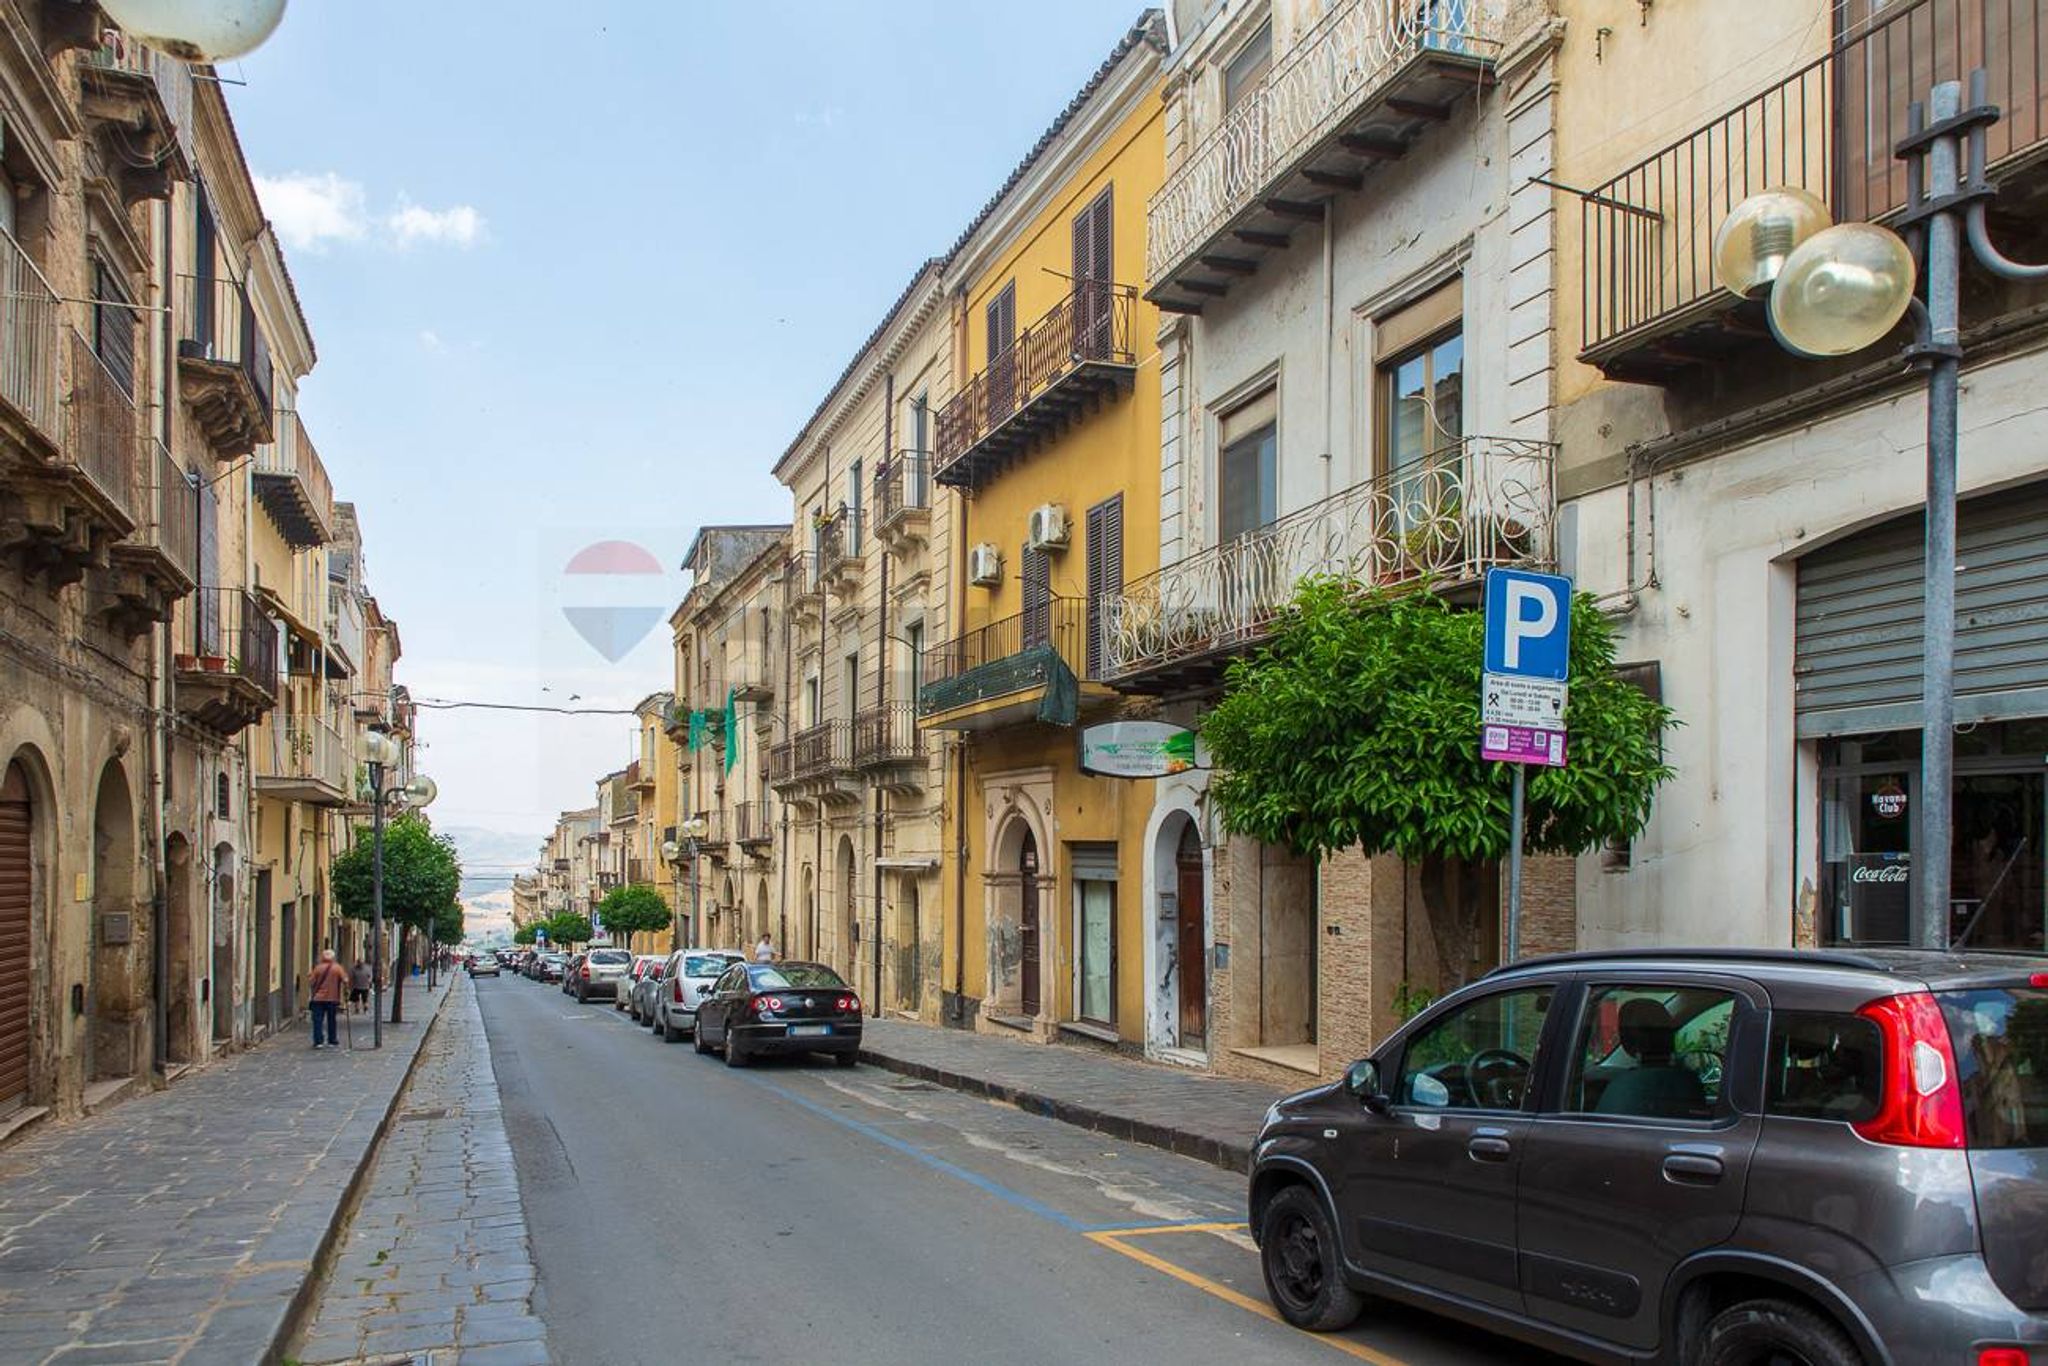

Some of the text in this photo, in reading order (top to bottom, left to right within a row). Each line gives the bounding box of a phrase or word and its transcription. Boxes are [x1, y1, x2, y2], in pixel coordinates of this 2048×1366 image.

[1504, 579, 1557, 668] P
[1872, 794, 1907, 804] Havana
[1880, 803, 1900, 813] Club
